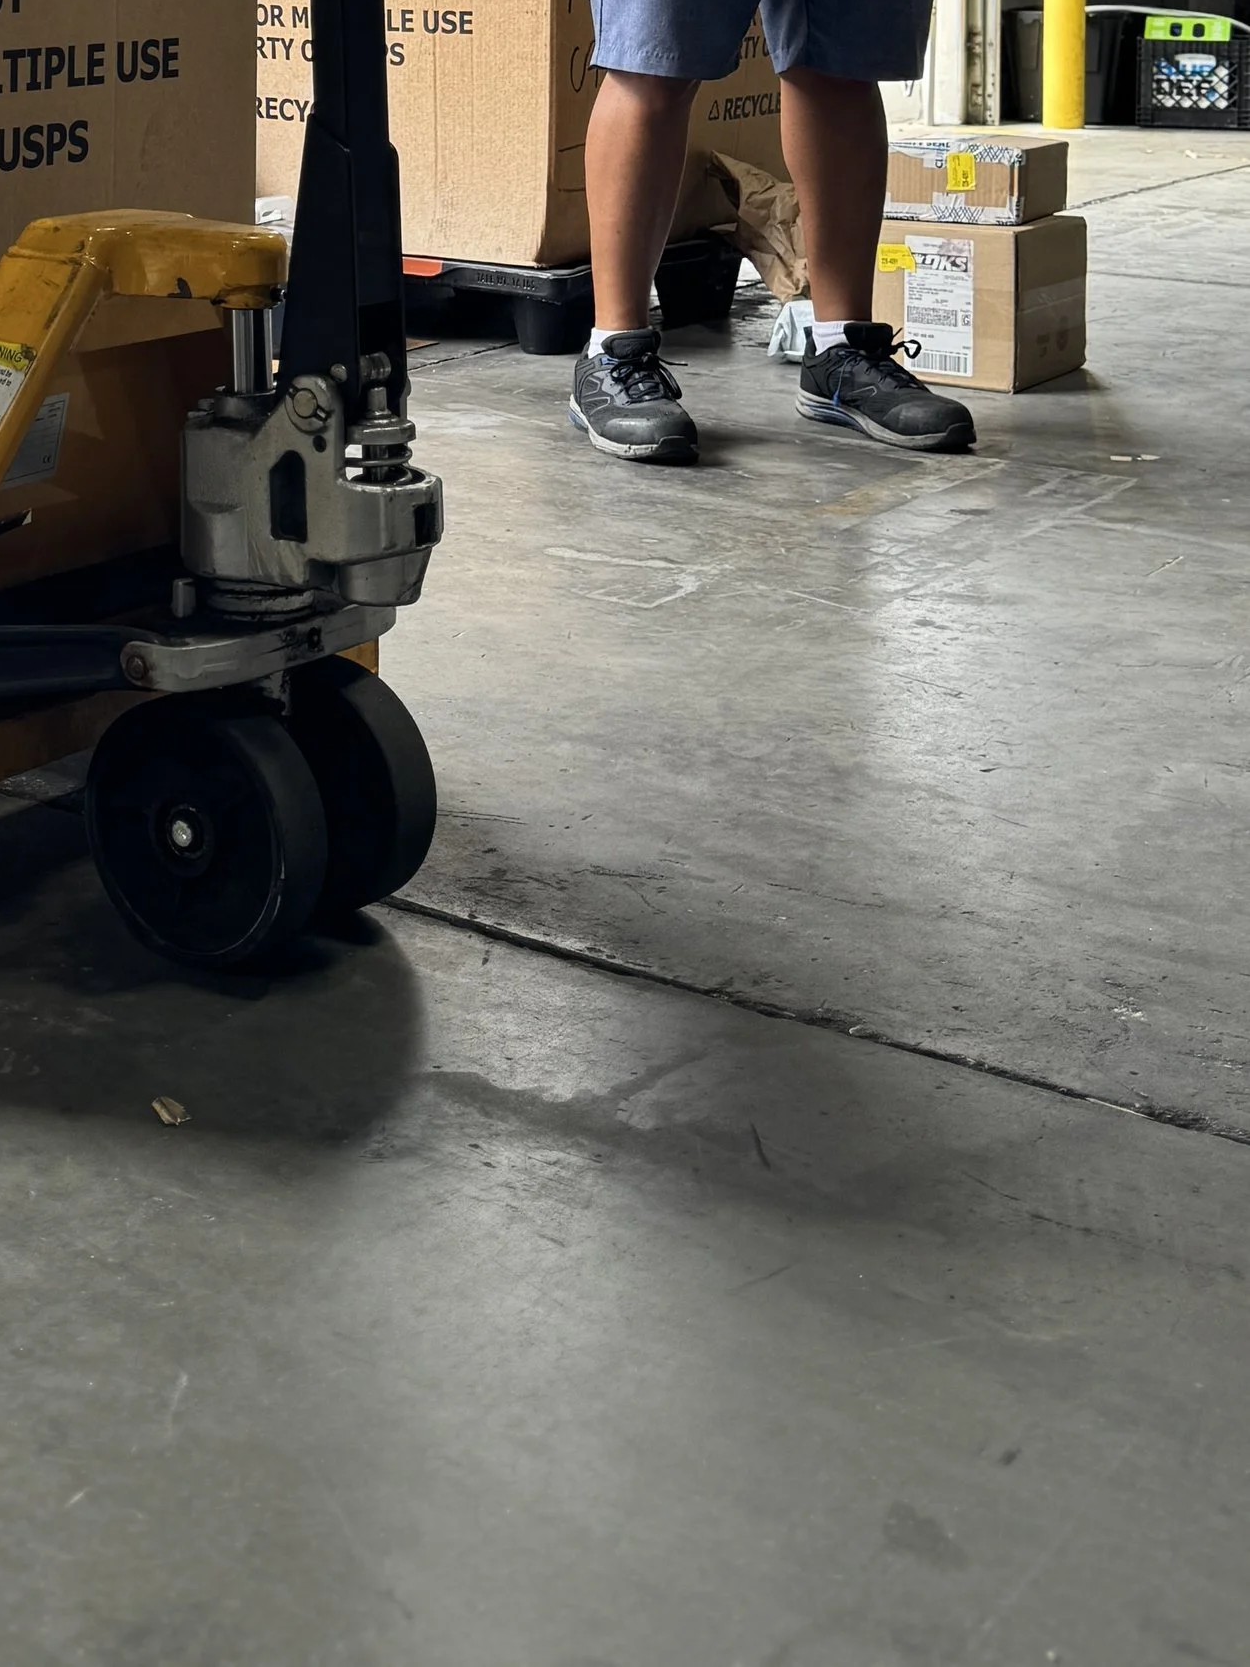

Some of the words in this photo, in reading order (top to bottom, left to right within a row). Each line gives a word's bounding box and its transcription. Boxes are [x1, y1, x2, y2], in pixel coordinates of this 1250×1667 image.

[423, 11, 474, 35] USE
[116, 37, 181, 83] USE
[256, 96, 314, 123] RECY
